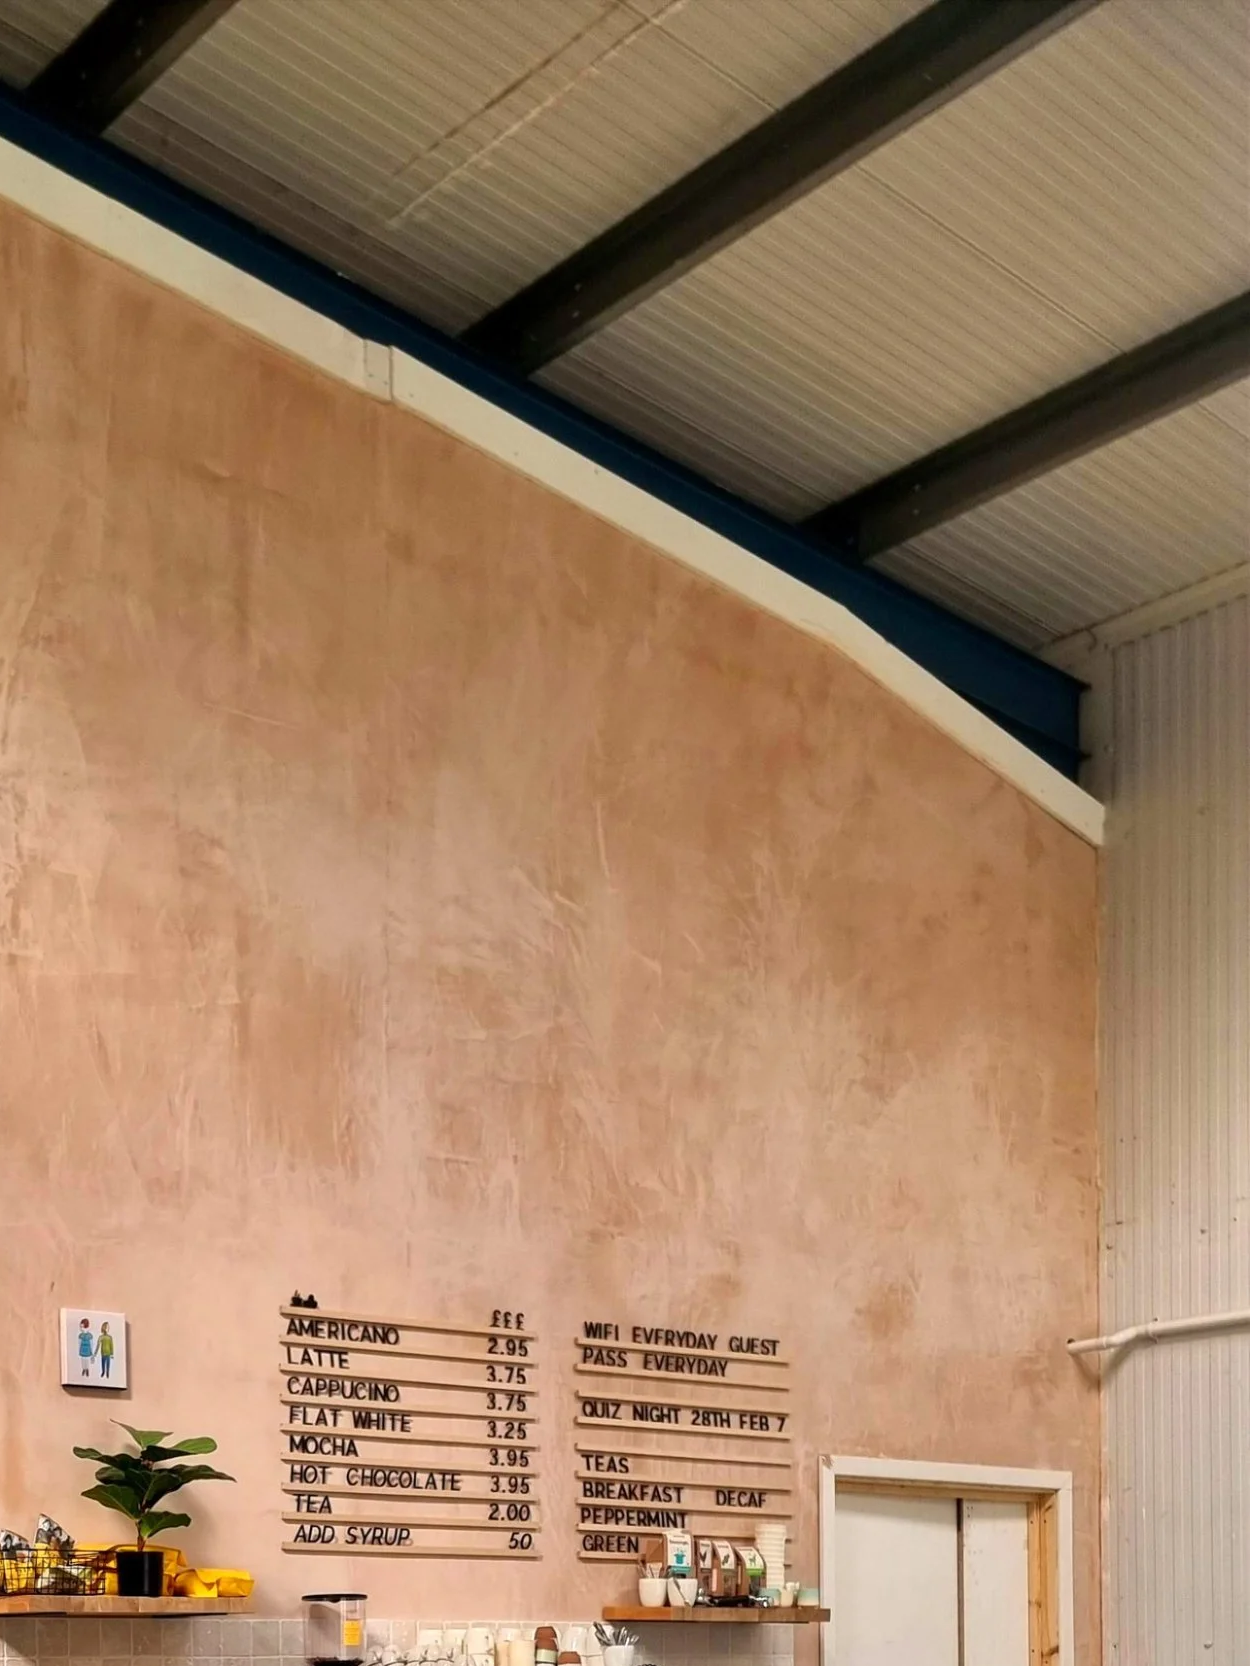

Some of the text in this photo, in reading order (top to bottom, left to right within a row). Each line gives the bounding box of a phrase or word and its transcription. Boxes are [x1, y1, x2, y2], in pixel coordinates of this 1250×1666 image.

[489, 1309, 524, 1331] £££
[286, 1318, 528, 1357] AMERICANO 2.95
[584, 1321, 619, 1341] WIFI
[729, 1336, 780, 1356] GUEST
[286, 1346, 526, 1385] LATTE 3.75
[582, 1347, 728, 1377] PASS EVERYDAY
[287, 1376, 526, 1412] CAPPUCINO 3.75
[289, 1405, 527, 1440] FLAT WHITE 3.25
[582, 1401, 788, 1433] QUIZ NIGHT 28TH FEB 7
[289, 1435, 529, 1467] MOCHA 3.95
[581, 1454, 629, 1474] TEAS
[290, 1464, 530, 1494] HOT CHOCOLATE 3.95
[293, 1494, 530, 1521] TEA 2.00
[583, 1481, 768, 1508] BREAKFAST DECAF
[581, 1507, 688, 1529] PEPPERMINT
[294, 1524, 532, 1550] ADD SYRUP 50
[582, 1535, 639, 1553] GREEN
